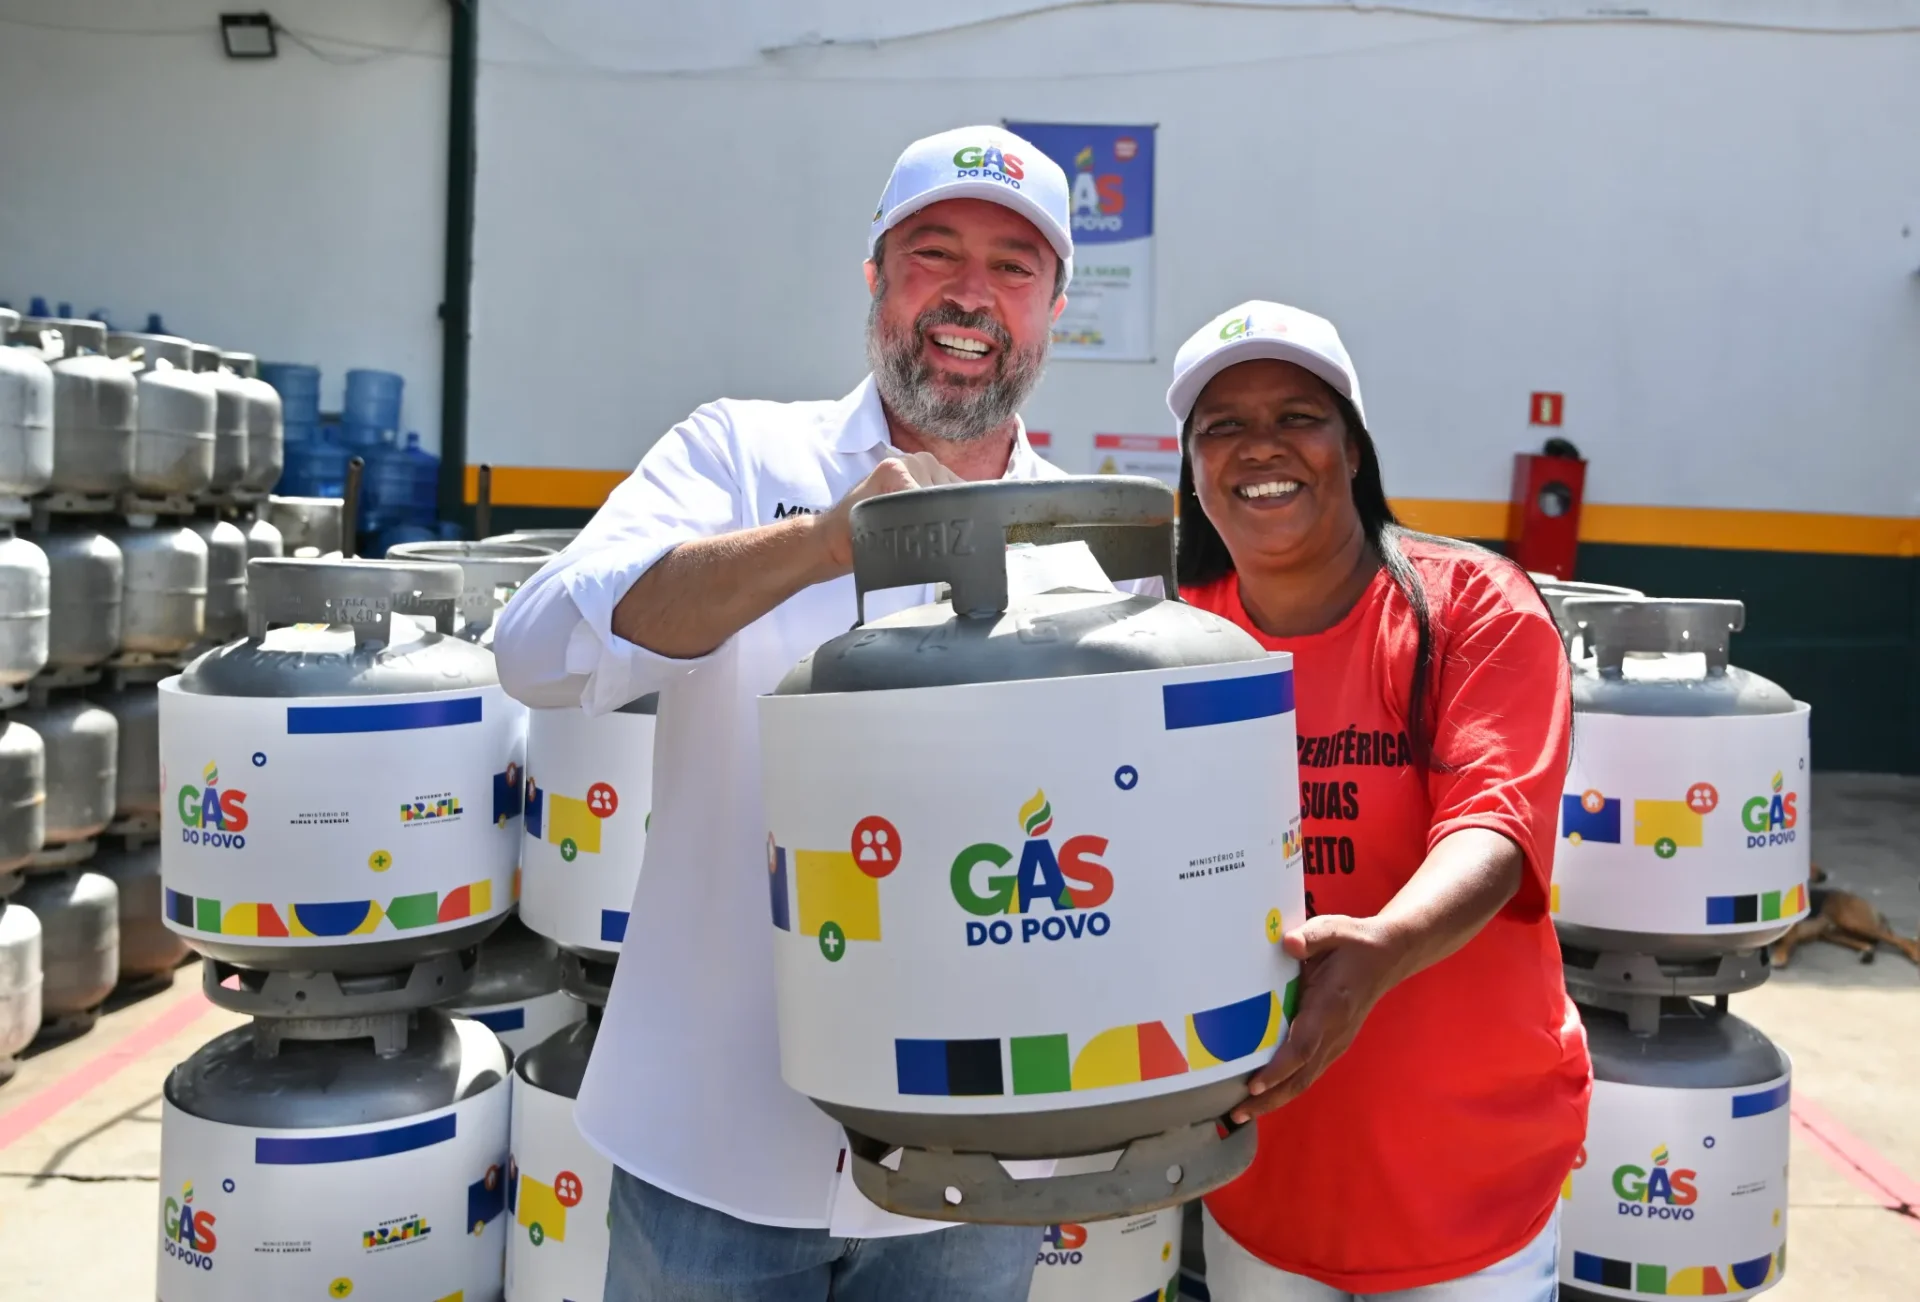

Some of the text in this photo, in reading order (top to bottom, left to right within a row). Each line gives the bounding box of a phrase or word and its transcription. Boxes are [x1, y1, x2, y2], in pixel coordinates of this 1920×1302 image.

[957, 169, 1021, 190] DO POVO
[400, 797, 464, 822] BRASIL
[1301, 781, 1359, 821] SUAS
[182, 827, 246, 850] DO POVO
[1746, 829, 1796, 849] DO POVO
[1236, 849, 1245, 858] DE
[1179, 860, 1246, 881] MINAS E ENERGIA
[966, 911, 1111, 947] DO POVO
[1618, 1202, 1695, 1222] DO POVO
[363, 1216, 432, 1249] BRASIL
[165, 1237, 214, 1271] DO POVO
[1035, 1251, 1083, 1266] POVO
